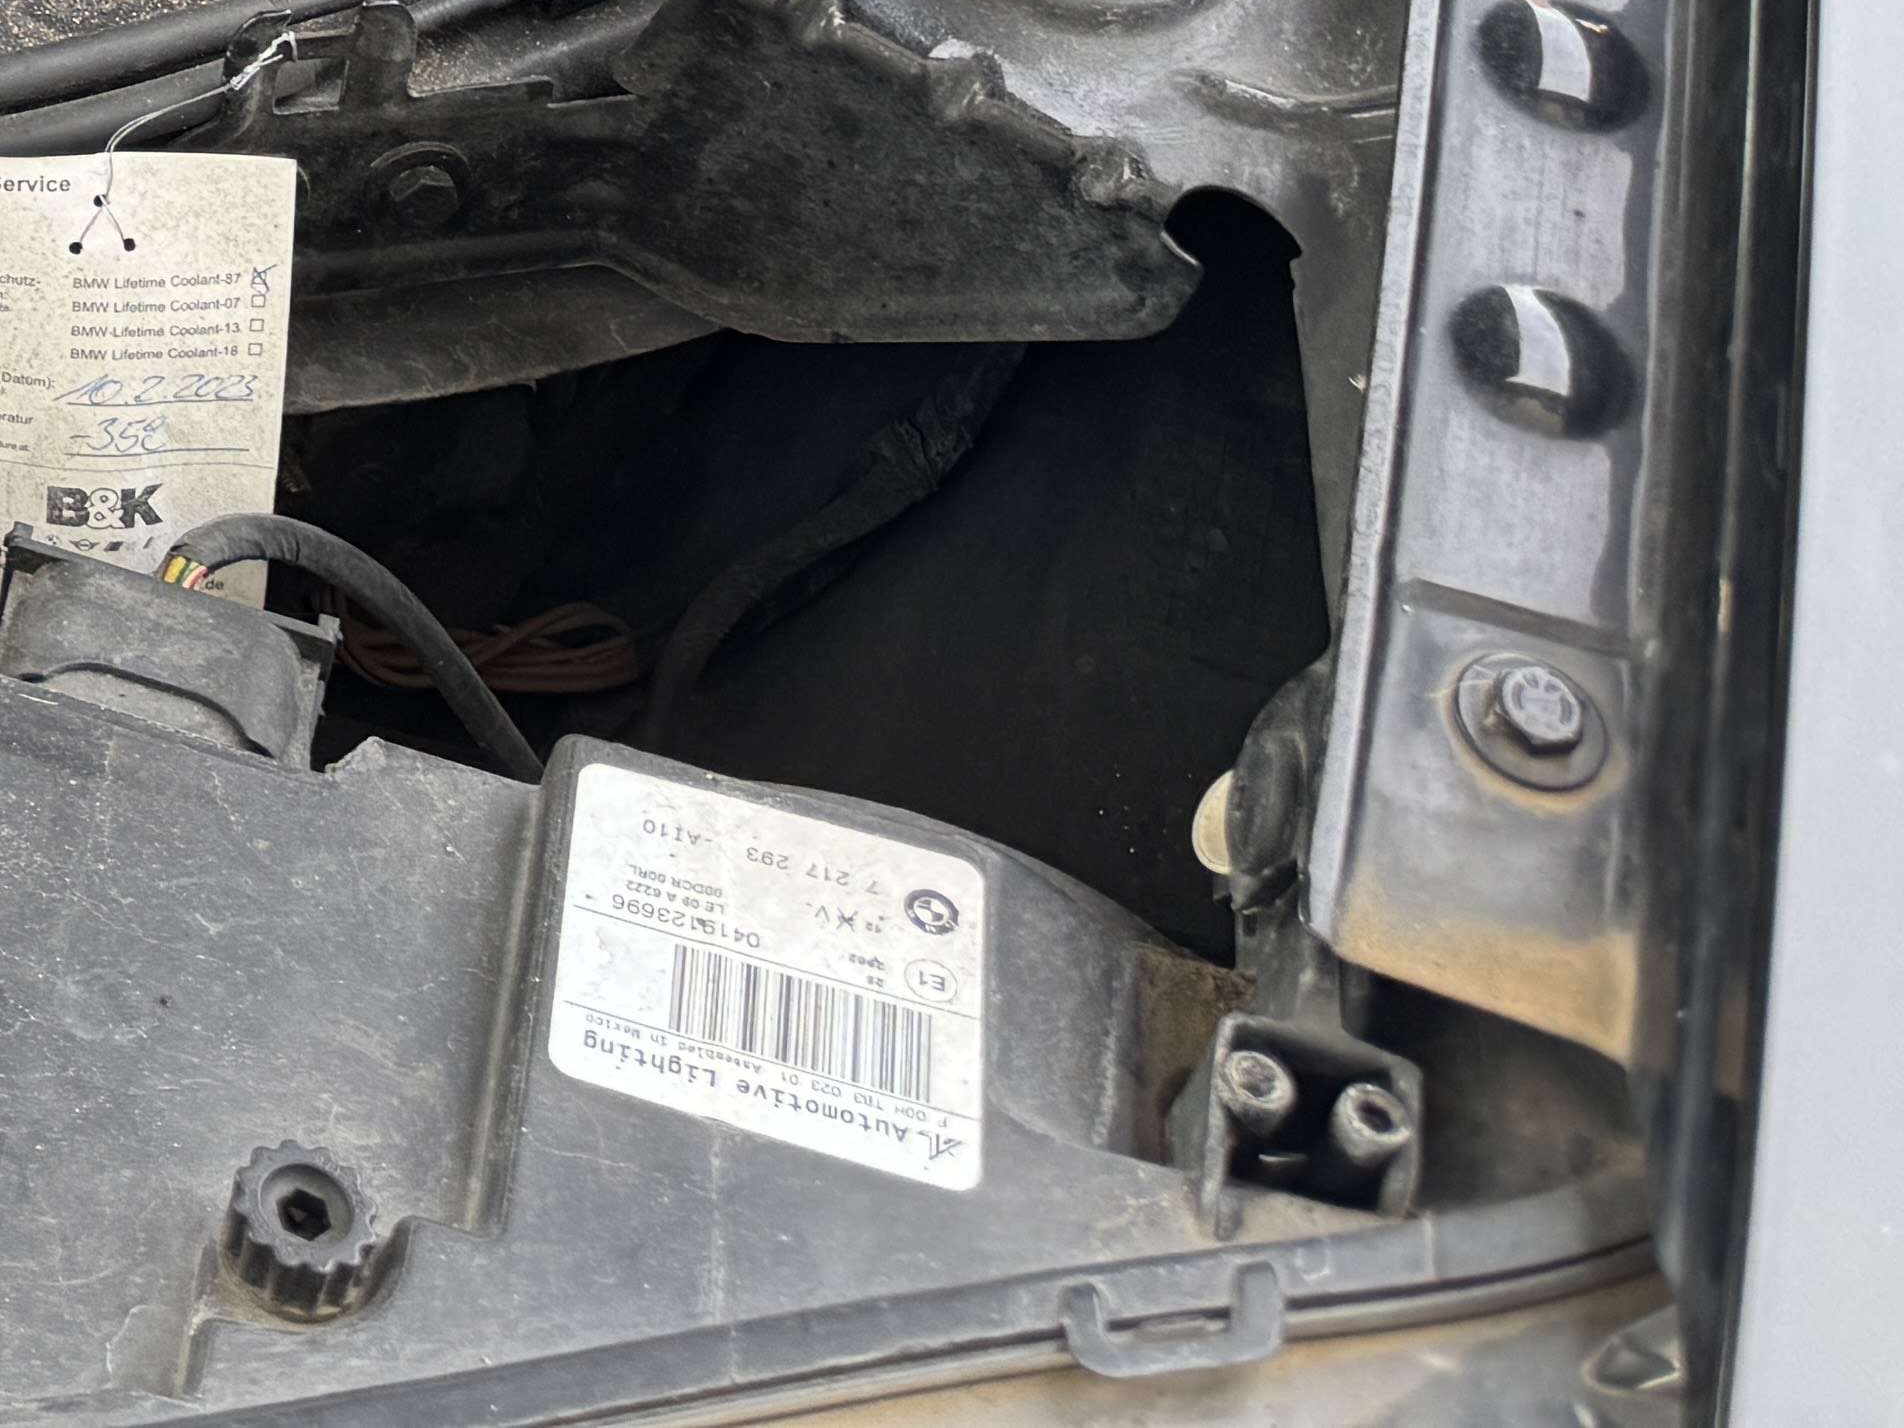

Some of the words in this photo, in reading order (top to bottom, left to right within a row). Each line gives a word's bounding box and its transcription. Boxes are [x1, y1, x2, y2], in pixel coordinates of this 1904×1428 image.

[73, 277, 110, 289] BMW
[114, 277, 166, 289] Lifetime
[72, 301, 109, 313] BMW
[113, 300, 166, 313] Lifetime
[170, 297, 241, 312] Coolant-07
[71, 325, 108, 337] BMW
[112, 325, 165, 338] Lifetime
[169, 322, 240, 336] Coolant-13
[70, 348, 107, 360] BMW
[111, 348, 163, 361] Lifetime
[47, 483, 163, 530] B&K
[746, 846, 790, 870] 293
[804, 861, 852, 887] 217
[612, 893, 760, 949] 0419123696
[918, 968, 947, 993] E1
[585, 1012, 641, 1040] Mexico
[583, 1029, 718, 1088] Lighting
[811, 1079, 843, 1098] 023
[736, 1078, 910, 1143] Automotive
